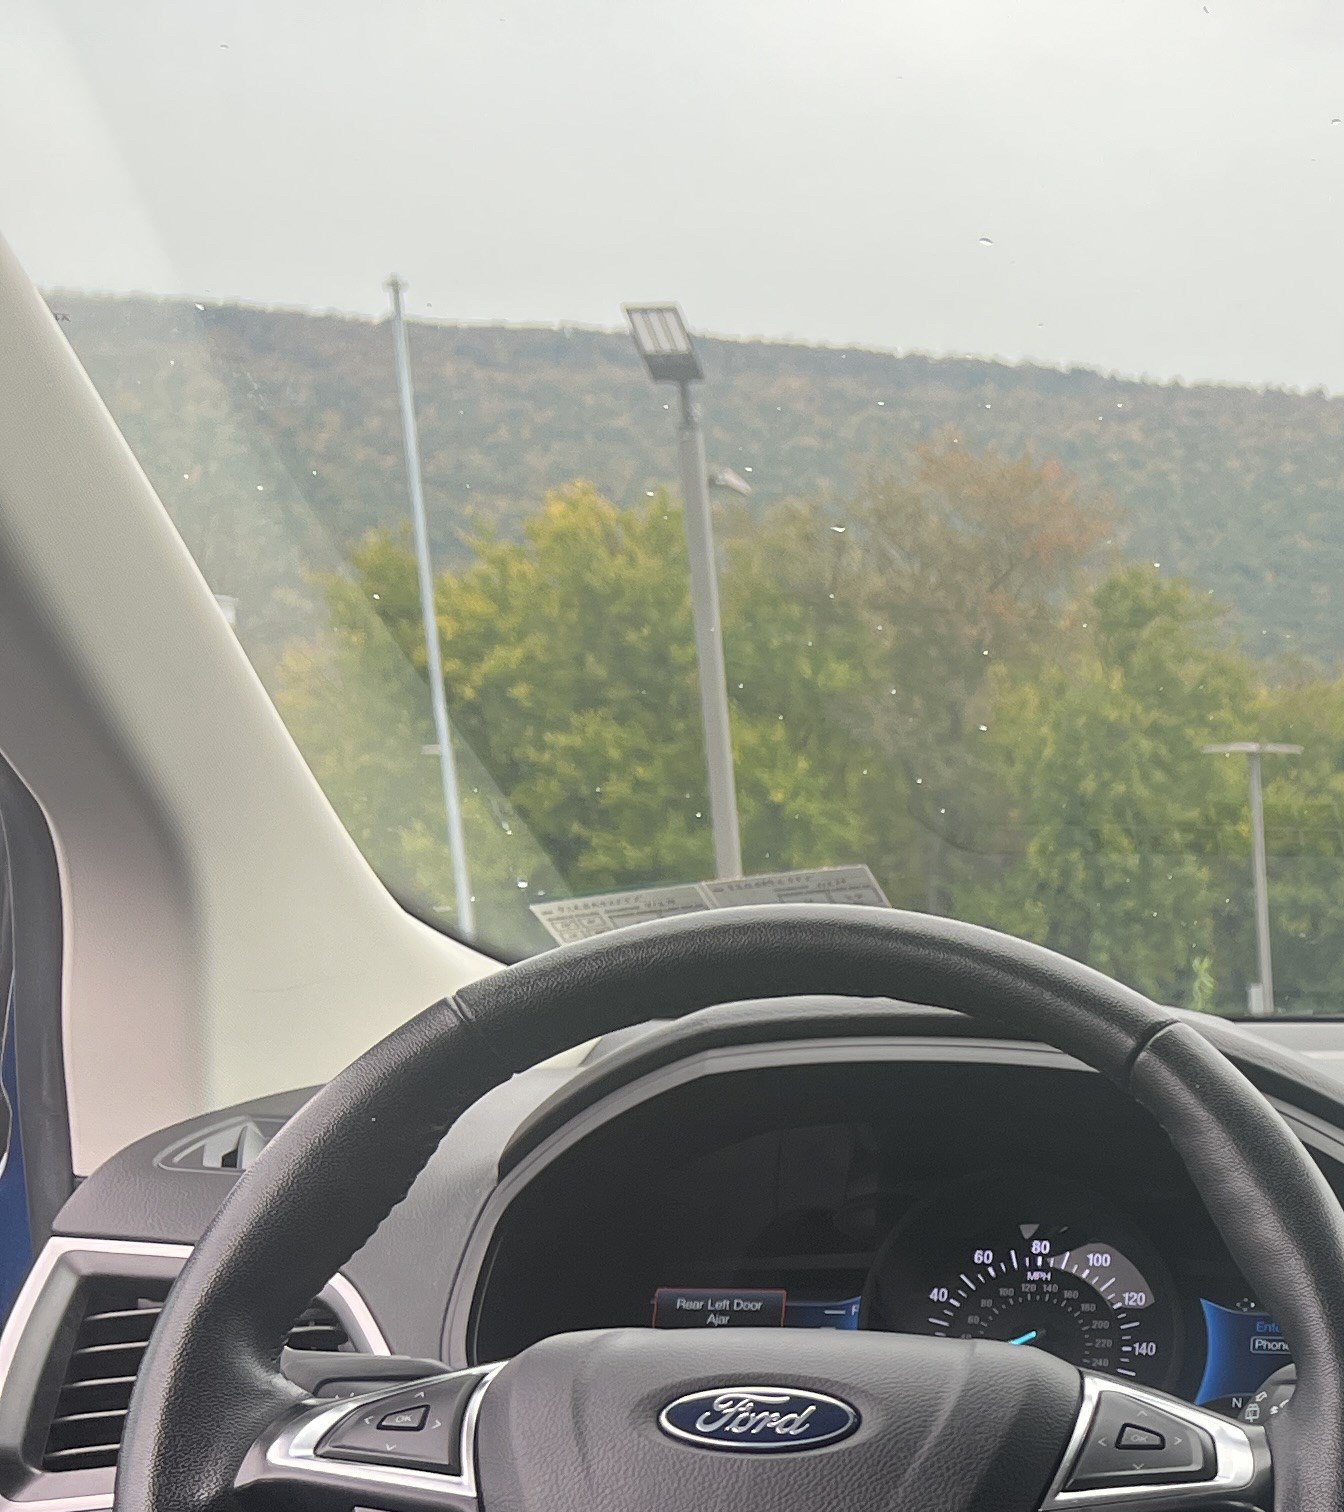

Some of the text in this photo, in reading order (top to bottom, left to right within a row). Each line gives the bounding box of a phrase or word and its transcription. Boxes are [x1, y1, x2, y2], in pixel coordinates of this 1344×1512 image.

[1031, 1240, 1051, 1254] 80
[974, 1250, 993, 1264] 60
[1087, 1254, 1111, 1267] 100
[1027, 1272, 1052, 1281] MPH
[929, 1288, 948, 1302] 40
[1021, 1284, 1036, 1293] 120
[1043, 1284, 1059, 1293] 140
[676, 1298, 763, 1311] Rear Left Door
[1122, 1292, 1146, 1306] 120
[707, 1313, 730, 1327] Ajar
[1092, 1320, 1110, 1330] 200
[1095, 1339, 1113, 1349] 220
[1133, 1343, 1156, 1356] 140
[1231, 1397, 1243, 1409] N
[394, 1413, 412, 1424] OK
[695, 1392, 817, 1435] Ford
